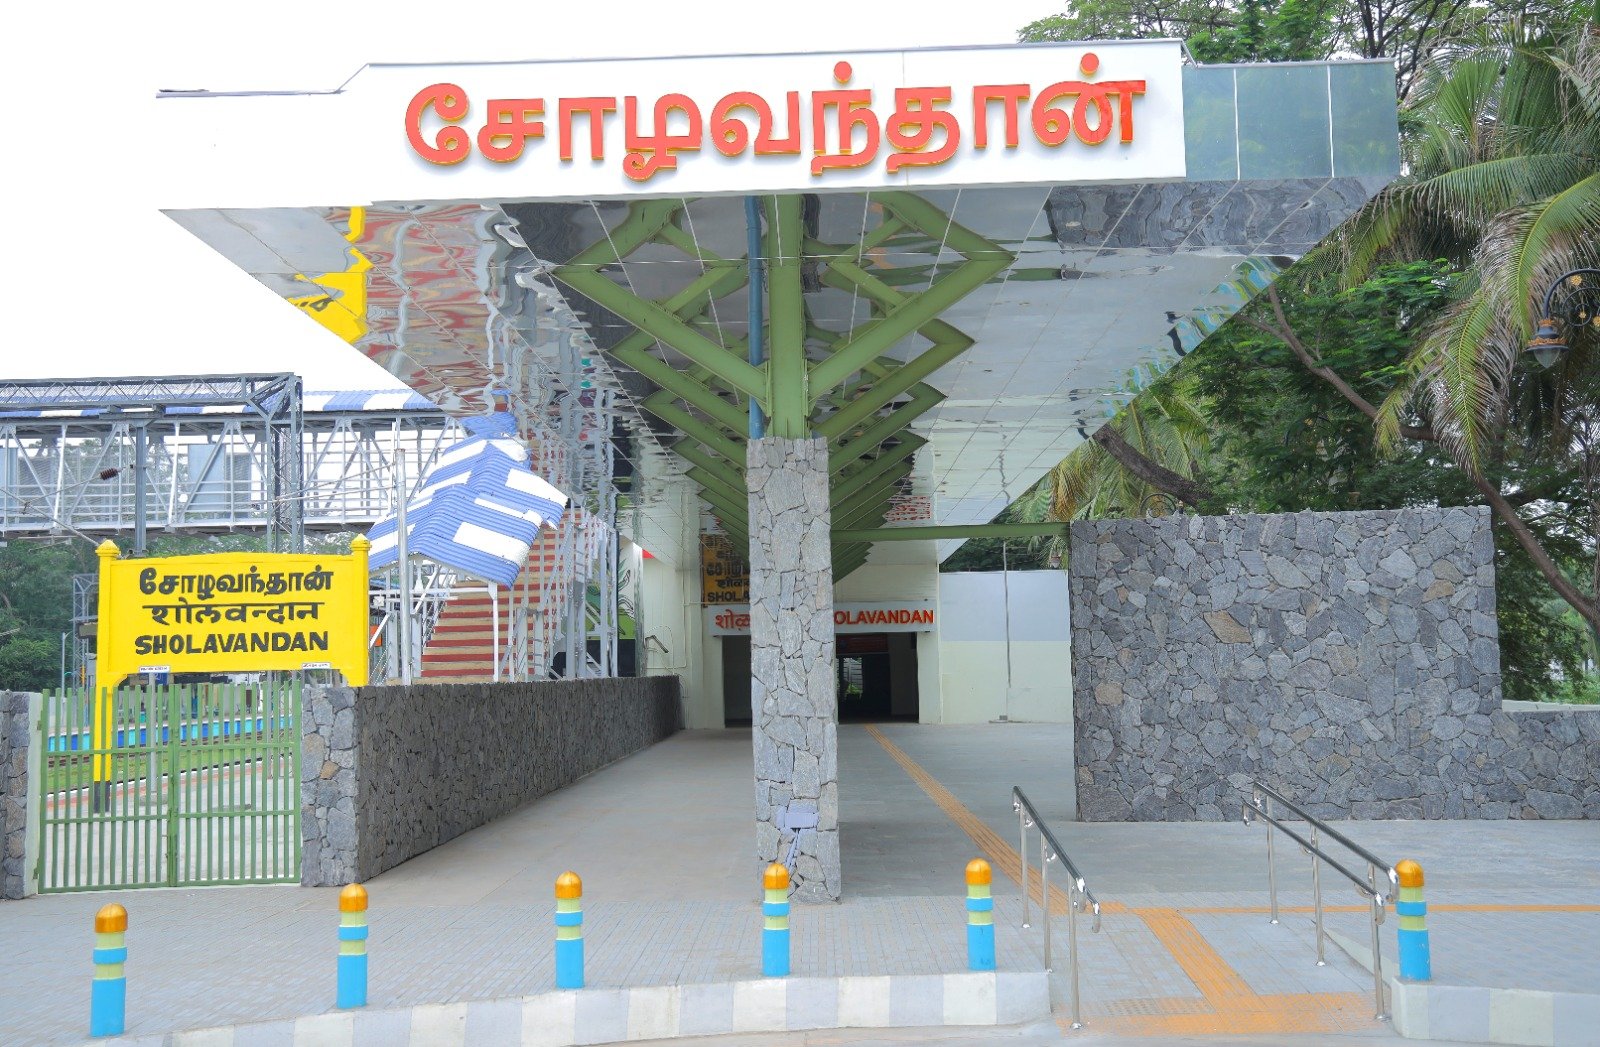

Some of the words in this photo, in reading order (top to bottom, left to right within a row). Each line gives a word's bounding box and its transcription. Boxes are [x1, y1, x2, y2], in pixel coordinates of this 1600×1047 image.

[405, 52, 1147, 181] சோழவந்தான்
[139, 565, 334, 600] சோழவந்தான்
[142, 597, 325, 626] शोलवन्दान
[834, 609, 934, 625] OLAVANDAN
[135, 631, 328, 655] SHOLAVANDAN
